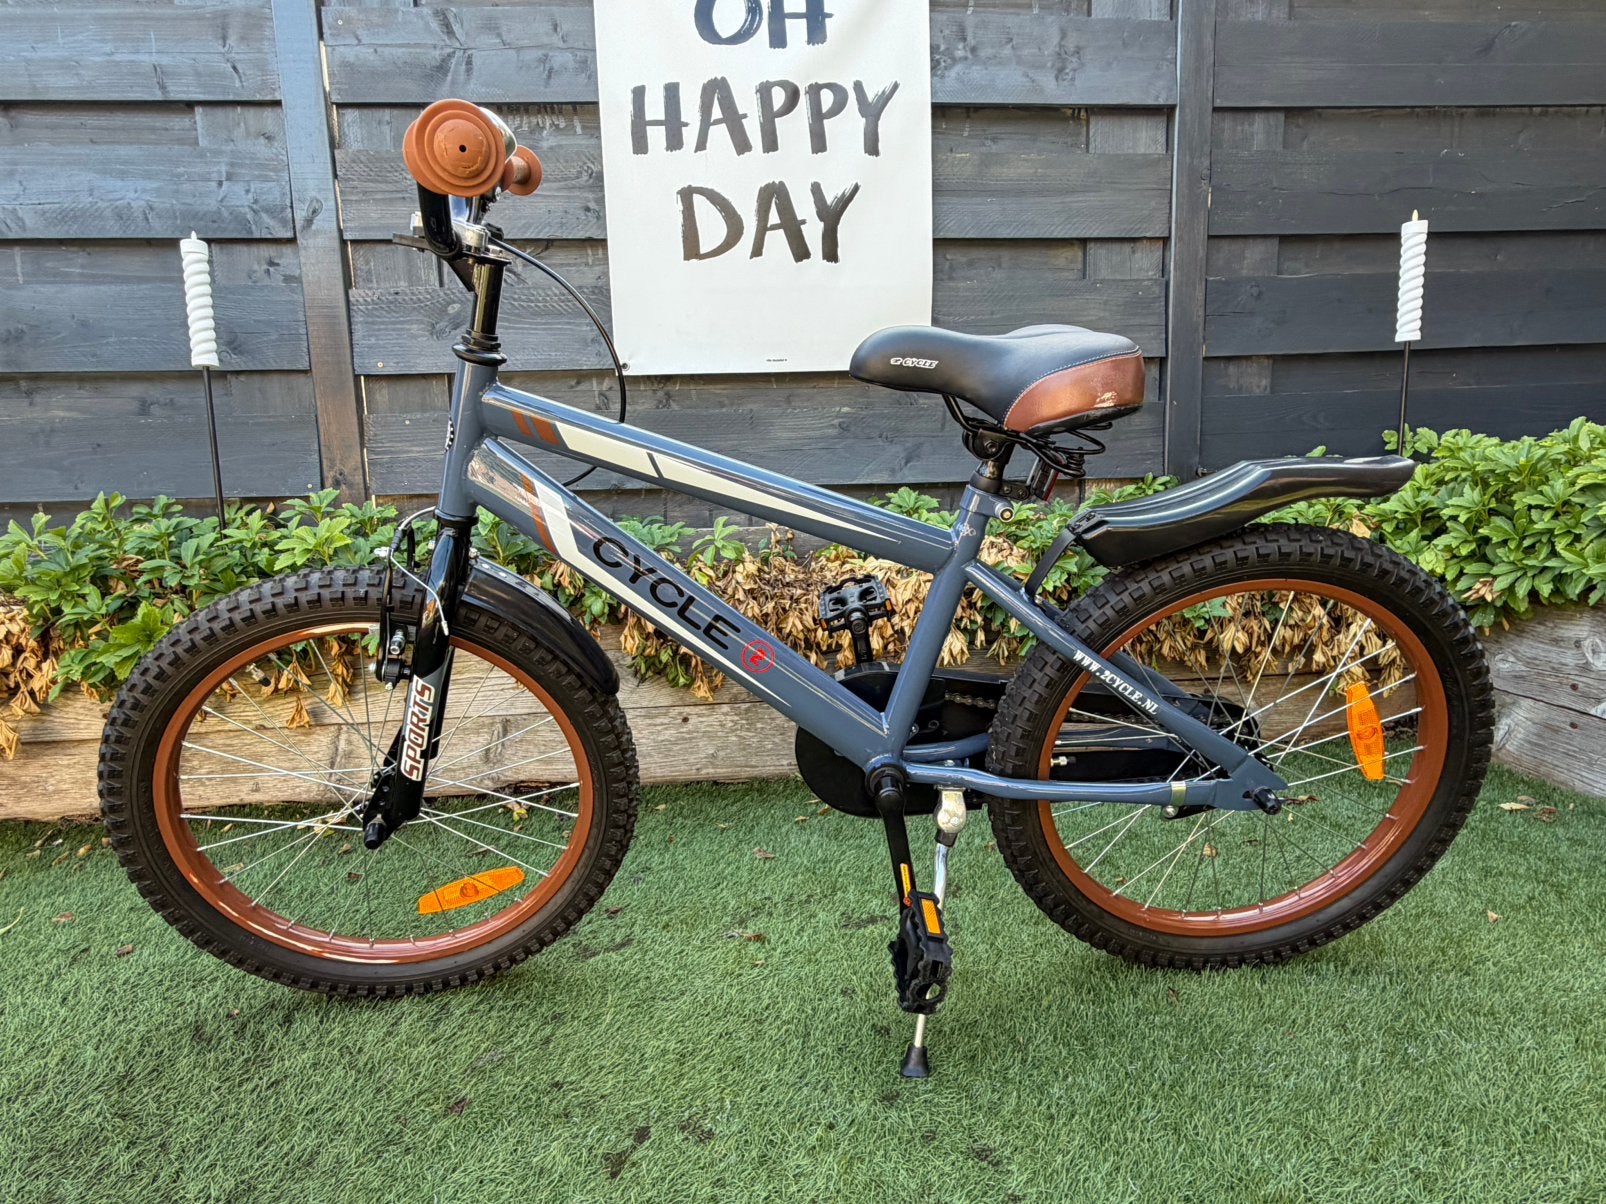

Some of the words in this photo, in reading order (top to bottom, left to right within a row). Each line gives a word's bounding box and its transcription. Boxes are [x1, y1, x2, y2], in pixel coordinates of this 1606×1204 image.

[694, 0, 834, 49] OH
[630, 76, 900, 157] HAPPY
[676, 180, 861, 264] DAY
[592, 536, 741, 650] CYCLE
[1073, 649, 1159, 715] WWW.2CYCLE.NL
[400, 674, 436, 782] SPORTS
